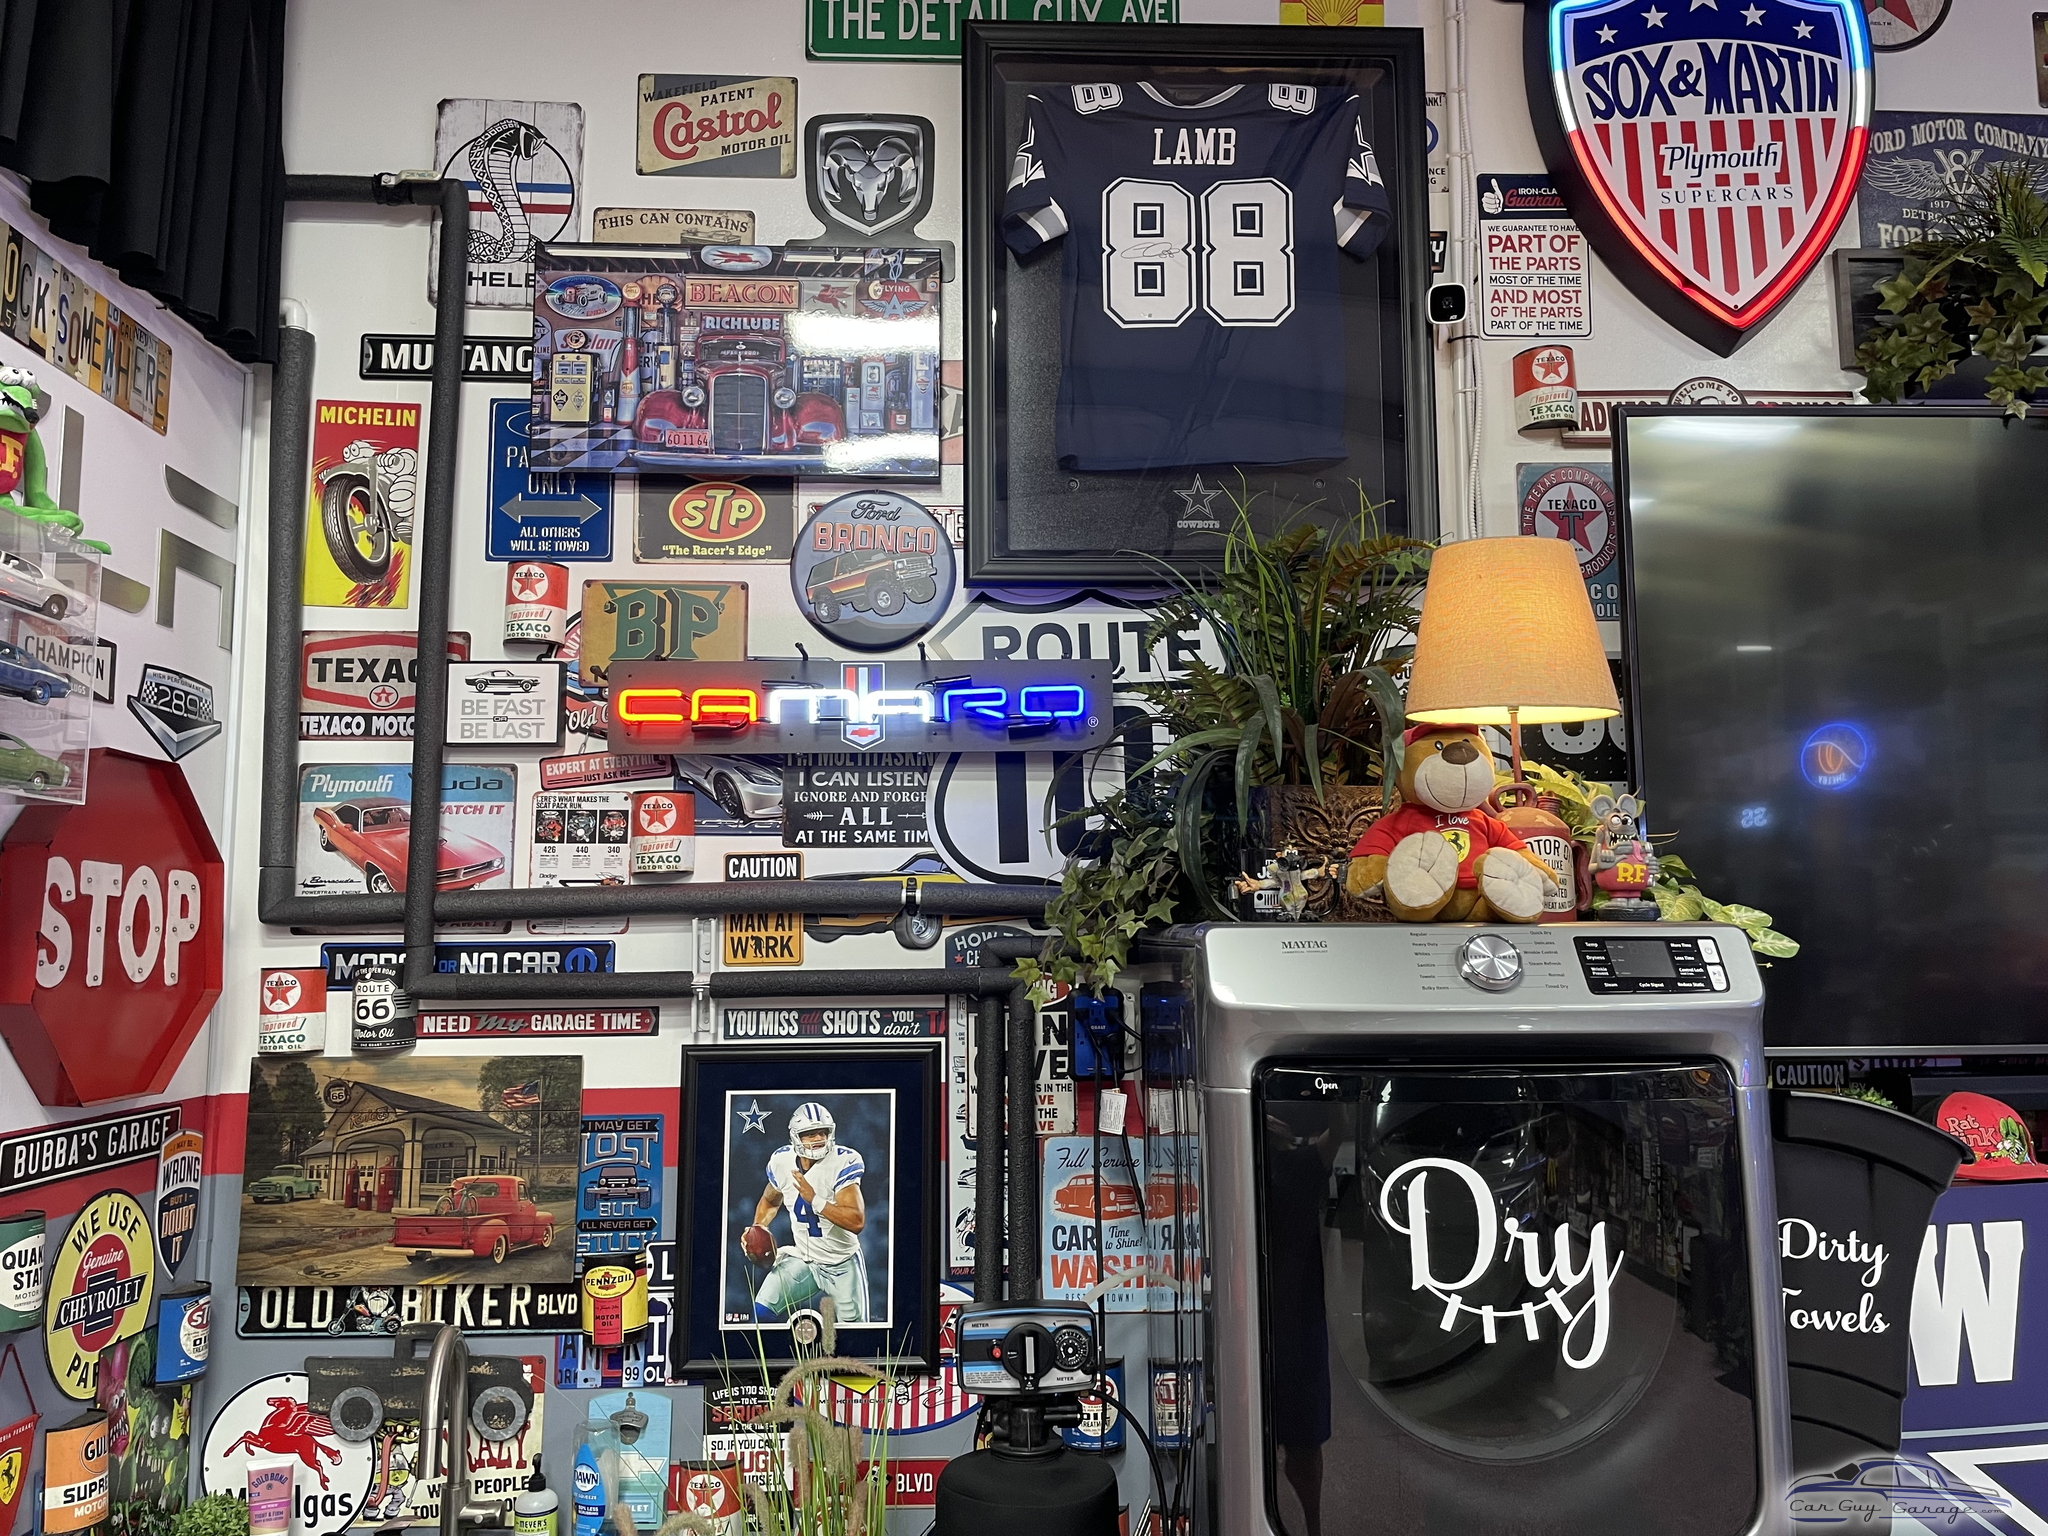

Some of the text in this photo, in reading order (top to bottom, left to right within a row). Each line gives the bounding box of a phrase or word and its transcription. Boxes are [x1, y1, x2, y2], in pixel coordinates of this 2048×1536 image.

[825, 0, 885, 40] THE
[1582, 42, 1838, 121] SOX MARTIN
[643, 81, 718, 103] WAKEFIELD
[701, 87, 754, 107] PATENT
[653, 92, 782, 161] Castrol
[1911, 118, 1967, 147] MOTOR
[721, 133, 792, 156] MOTOR OIL
[1152, 127, 1237, 166] LAMB
[1664, 142, 1778, 178] Plymouth
[1661, 187, 1793, 205] SUPERCARS
[599, 212, 749, 234] THIS CAN CONTAINS
[1101, 176, 1295, 328] 88
[1488, 234, 1581, 253] PART OF
[1489, 257, 1581, 271] THE PARTS
[1490, 276, 1581, 285] MOST OF THE TIME
[691, 283, 795, 305] BEACON
[1490, 290, 1582, 304] AND MOST
[1490, 306, 1583, 318] OF THE PARTS
[703, 315, 781, 332] RICHLUBE
[1491, 321, 1583, 330] PART OF THE TIME
[57, 293, 168, 422] SOMEWHERE
[1535, 391, 1570, 403] Improved
[320, 406, 416, 427] MICHELIN
[1529, 404, 1575, 416] TEXACO
[1560, 469, 1609, 497] COMPANY
[682, 491, 754, 534] STP
[850, 500, 902, 522] Ford
[1547, 499, 1597, 510] TEXACO
[520, 526, 581, 538] ALL OTHERS
[1177, 520, 1220, 529] COWBOYS
[510, 540, 590, 553] WILL BE TOWED
[813, 523, 937, 555] BRONCO
[506, 622, 551, 634] TEXACO
[312, 657, 419, 683] TEXAC
[461, 698, 546, 716] BE FAST
[300, 715, 365, 736] TEXACO
[461, 722, 546, 739] BE LAST
[546, 758, 600, 777] EXPERT AT
[584, 769, 631, 783] JUST ASK ME
[310, 773, 395, 798] Plymouth
[812, 771, 928, 787] CAN LISTEN
[558, 795, 598, 803] WHAT MAKES
[794, 791, 880, 803] IGNORE AND
[839, 806, 894, 826] ALL
[795, 830, 896, 843] AT THE SAME
[543, 846, 556, 854] 426
[575, 846, 589, 854] 440
[608, 846, 621, 854] 340
[635, 855, 681, 865] TEXACO
[729, 856, 797, 878] CAUTION
[35, 856, 201, 988] STOP
[729, 913, 769, 932] MAN
[1281, 940, 1328, 949] MAYTAG
[460, 952, 561, 974] NO CAR
[357, 984, 390, 993] ROUTE
[356, 999, 390, 1020] 66
[891, 1010, 914, 1024] YOU
[423, 1012, 642, 1033] NEED GARAGE TIME
[728, 1011, 757, 1036] YOU
[759, 1010, 799, 1035] MISS
[822, 1010, 880, 1035] SHOTS
[883, 1023, 921, 1036] don't
[260, 1034, 306, 1044] TEXACO
[1776, 1064, 1845, 1086] CAUTION
[1315, 1077, 1339, 1094] Open
[594, 1120, 652, 1131] MAY GET
[1947, 1115, 1980, 1132] Rat
[13, 1115, 172, 1179] BUBBA'S GARAGE
[580, 1131, 659, 1173] LOST
[1057, 1147, 1087, 1170] Full
[162, 1155, 201, 1192] WRONG
[599, 1202, 638, 1217] BUT
[71, 1202, 142, 1254] WE USE
[161, 1204, 196, 1239] DOUBT
[599, 1219, 652, 1230] NEVER GET
[1052, 1224, 1098, 1252] CAR
[1108, 1225, 1131, 1239] Time
[171, 1236, 181, 1264] IT
[1778, 1217, 1890, 1287] Dirty
[82, 1247, 125, 1278] Genuine
[1380, 1158, 1624, 1370] Dry
[586, 1273, 634, 1287] PENNZOIL
[60, 1279, 141, 1326] CHEVROLET
[260, 1284, 578, 1329] OLD BIKER BLVD
[624, 1366, 639, 1382] 99
[574, 1469, 599, 1486] DAWN
[896, 1473, 933, 1493] BLVD
